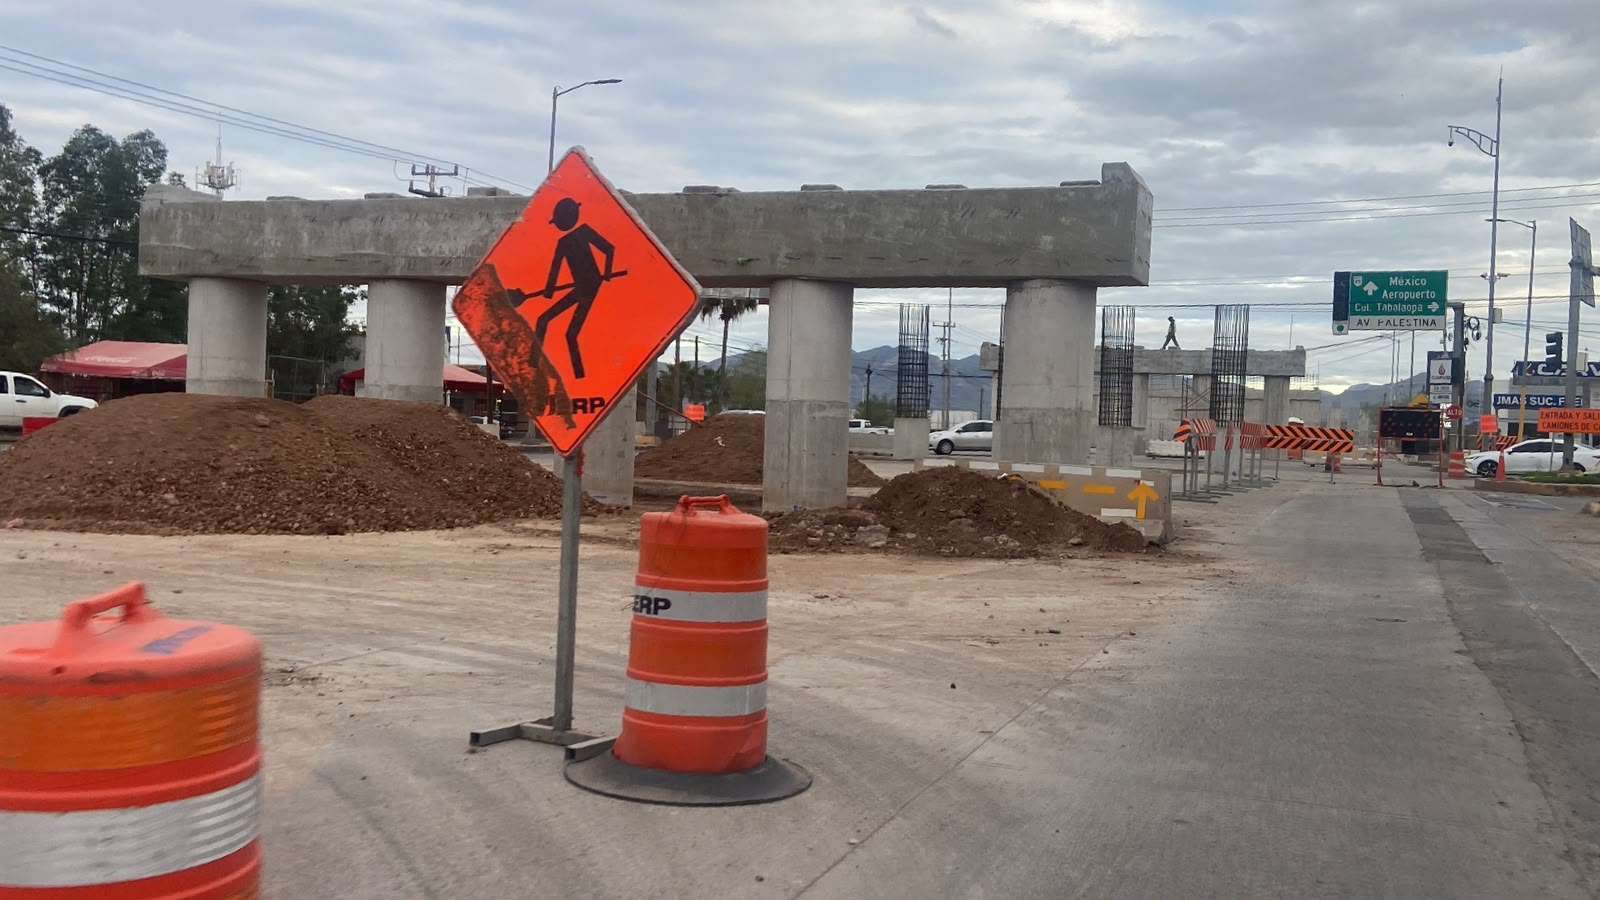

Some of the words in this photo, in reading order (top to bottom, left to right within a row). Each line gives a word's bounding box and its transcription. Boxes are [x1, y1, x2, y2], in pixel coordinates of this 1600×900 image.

[1382, 289, 1436, 301] Aeropuerto
[1356, 318, 1370, 327] AV
[1377, 318, 1437, 327] PALESTINA
[1540, 410, 1573, 420] ENTRADA
[1575, 411, 1581, 419] Y
[1542, 421, 1579, 430] CAMIONES
